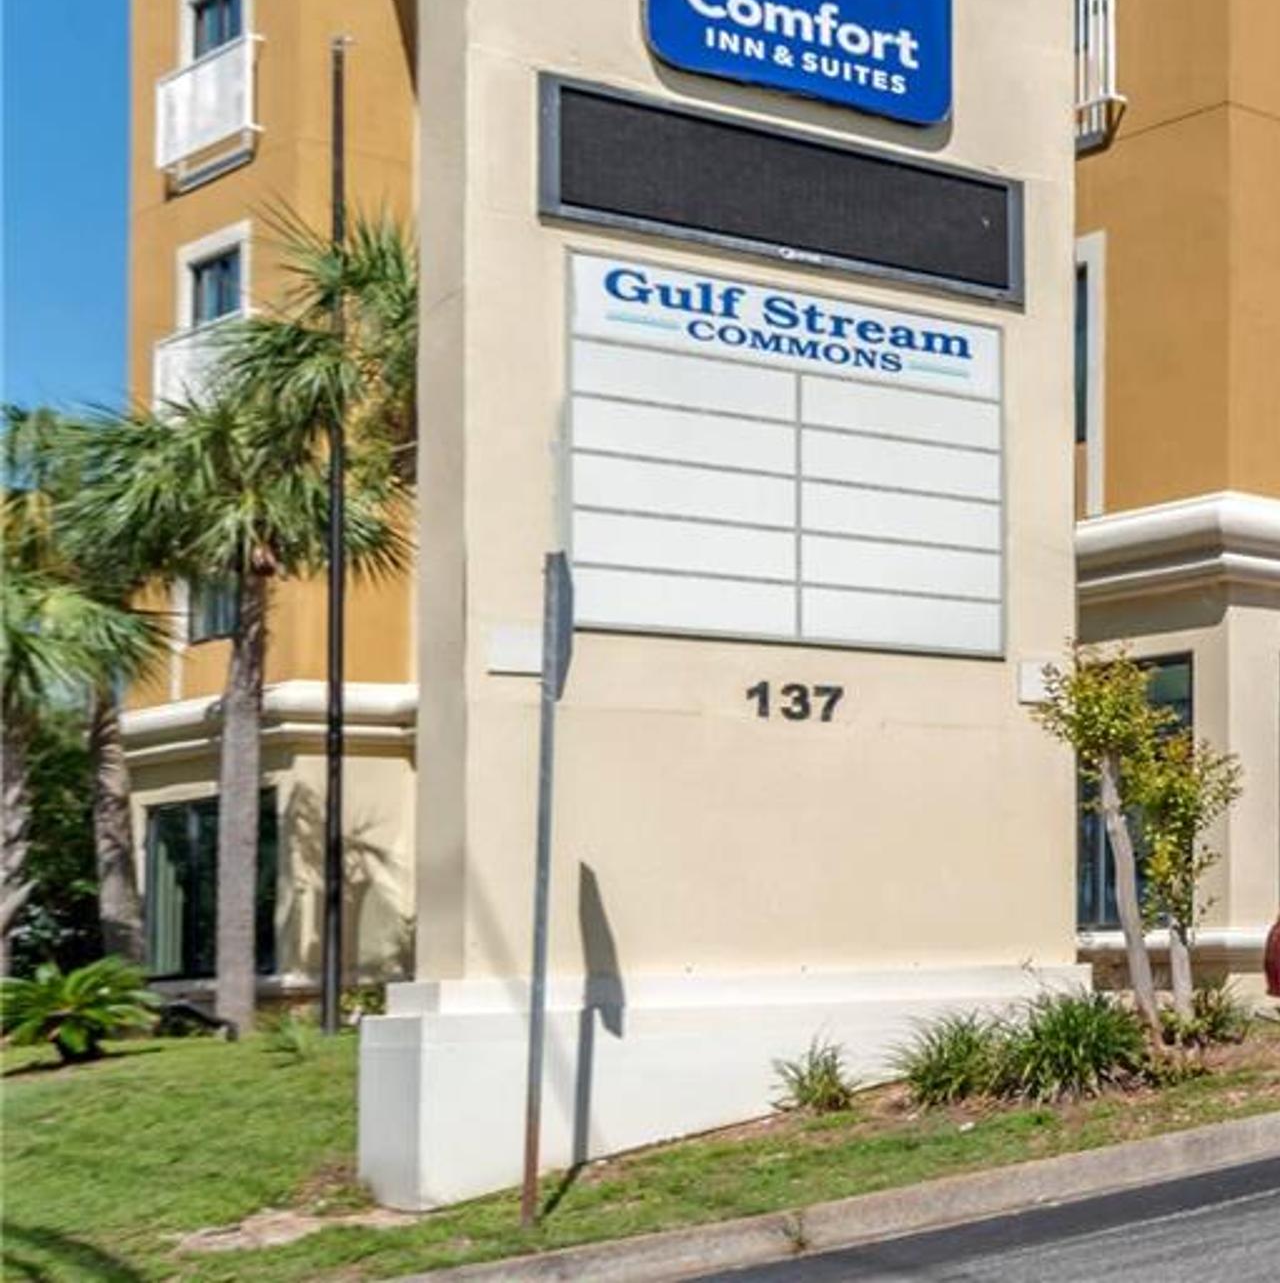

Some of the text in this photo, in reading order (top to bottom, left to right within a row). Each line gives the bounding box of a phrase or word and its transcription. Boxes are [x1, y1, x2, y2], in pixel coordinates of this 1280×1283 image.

[705, 27, 907, 95] INN & SUITES
[604, 268, 973, 360] Gulf Stream
[687, 320, 903, 373] COMMONS
[746, 680, 844, 723] 137
